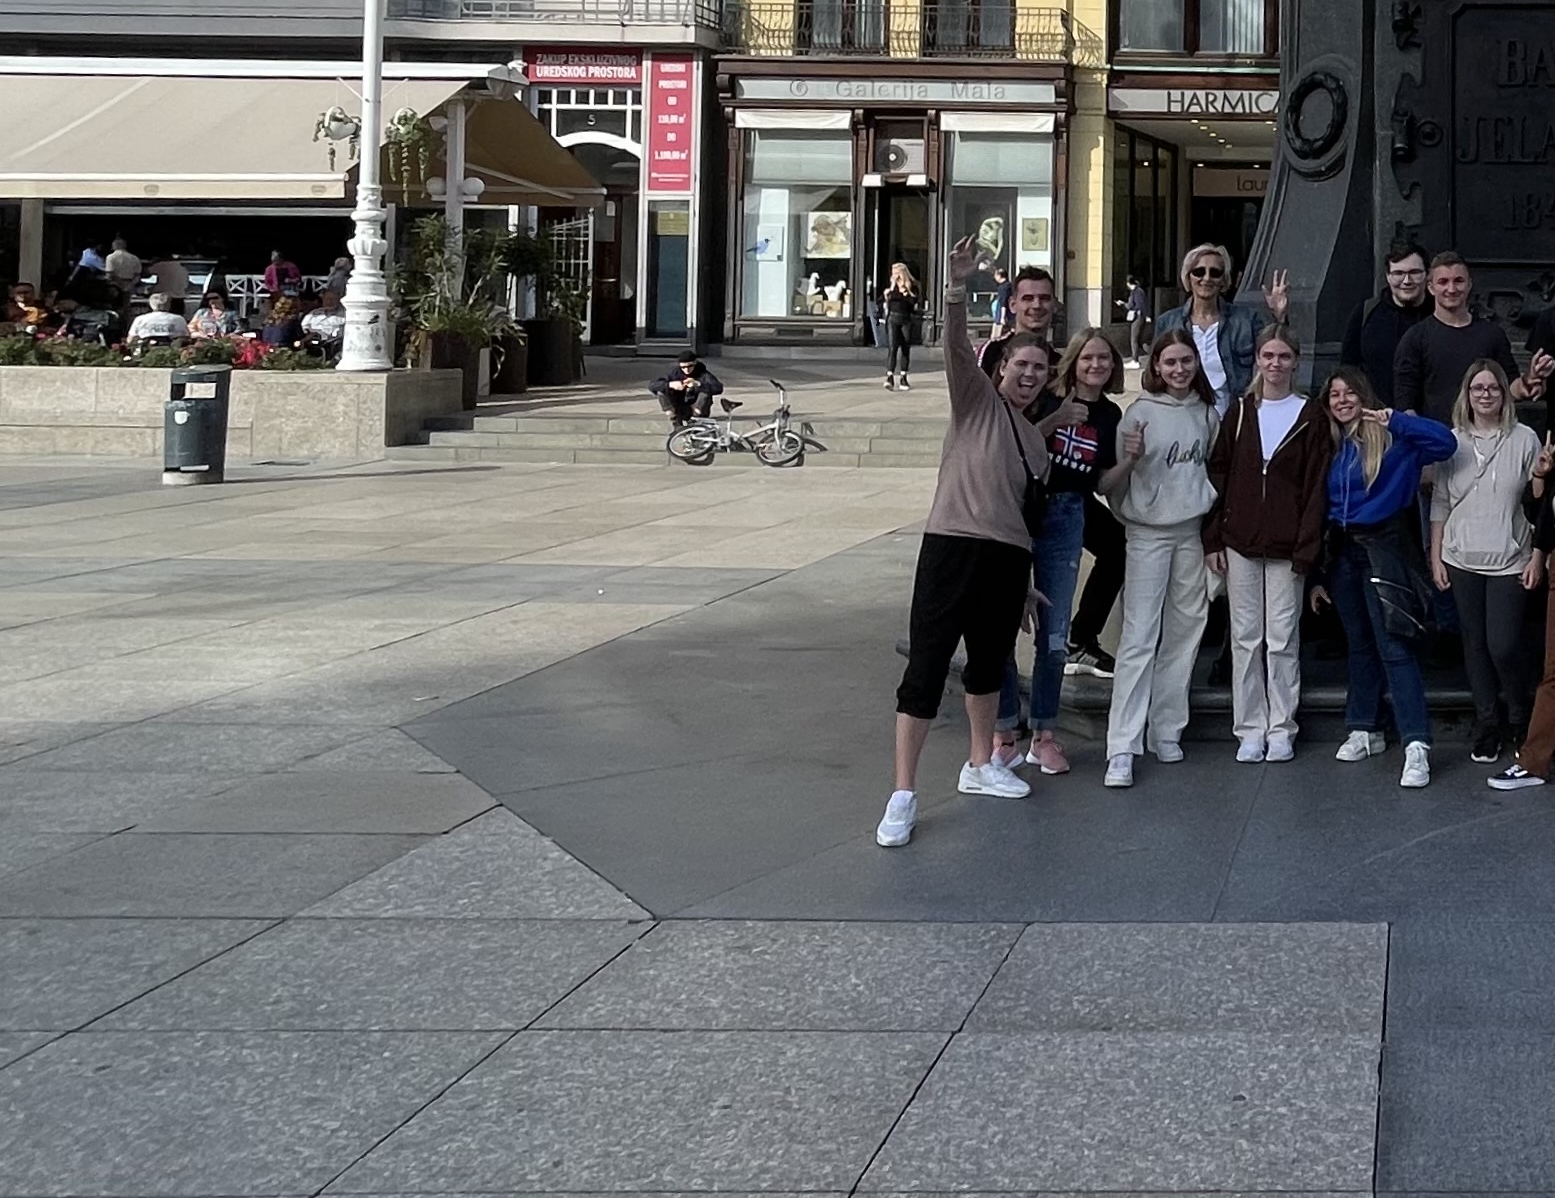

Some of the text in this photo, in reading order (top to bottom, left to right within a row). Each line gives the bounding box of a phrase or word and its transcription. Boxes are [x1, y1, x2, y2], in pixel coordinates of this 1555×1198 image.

[536, 54, 567, 65] ZAKUP
[536, 65, 637, 79] UREDSKOG PROSTORA
[835, 80, 1006, 101] Galerija Mala
